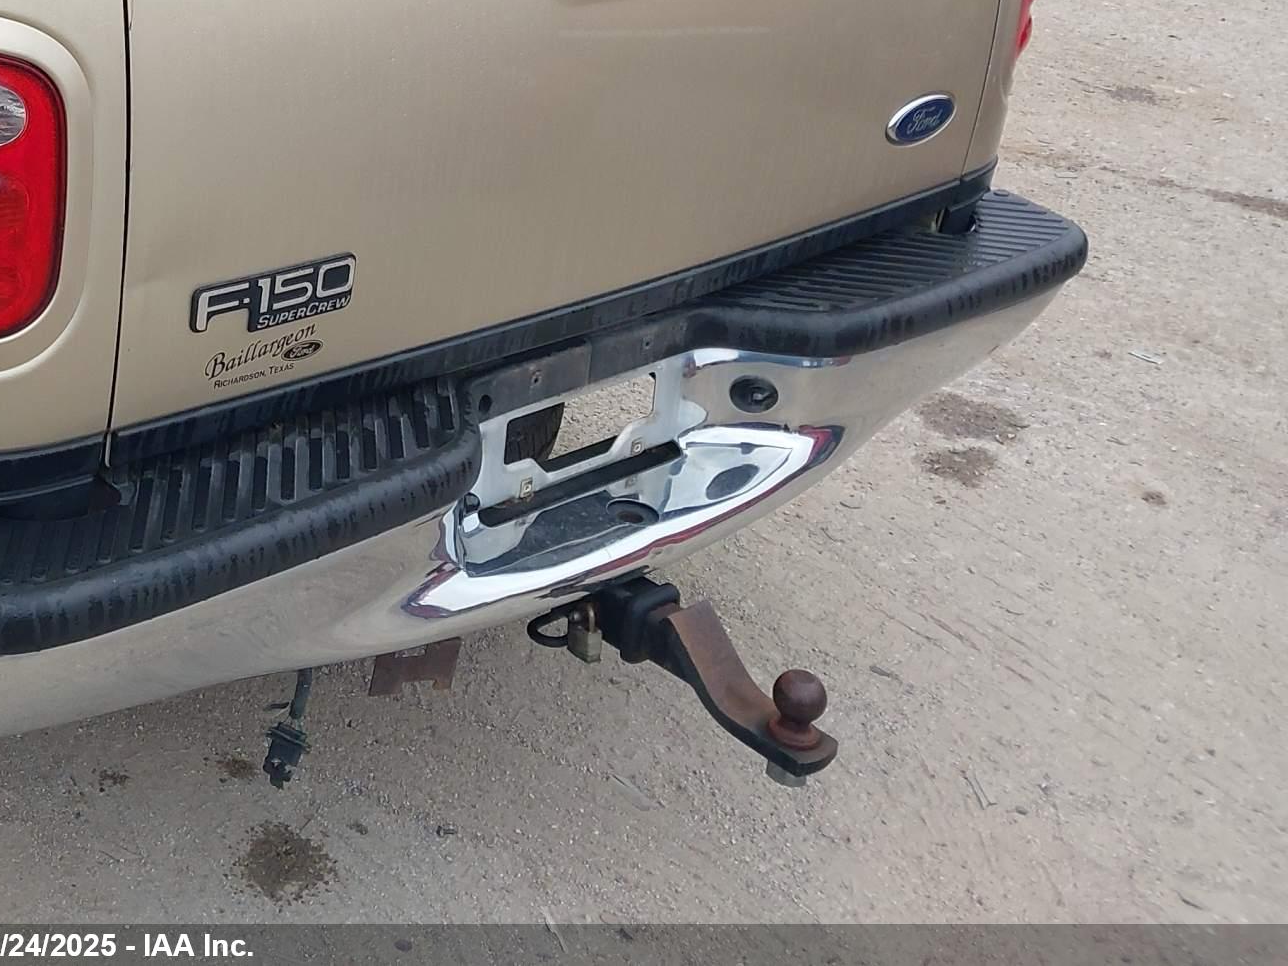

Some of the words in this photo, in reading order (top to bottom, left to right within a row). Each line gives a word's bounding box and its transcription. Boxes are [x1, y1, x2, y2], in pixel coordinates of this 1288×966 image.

[906, 106, 943, 135] Ford
[195, 257, 356, 331] F-150
[205, 323, 317, 381] Baillargeon
